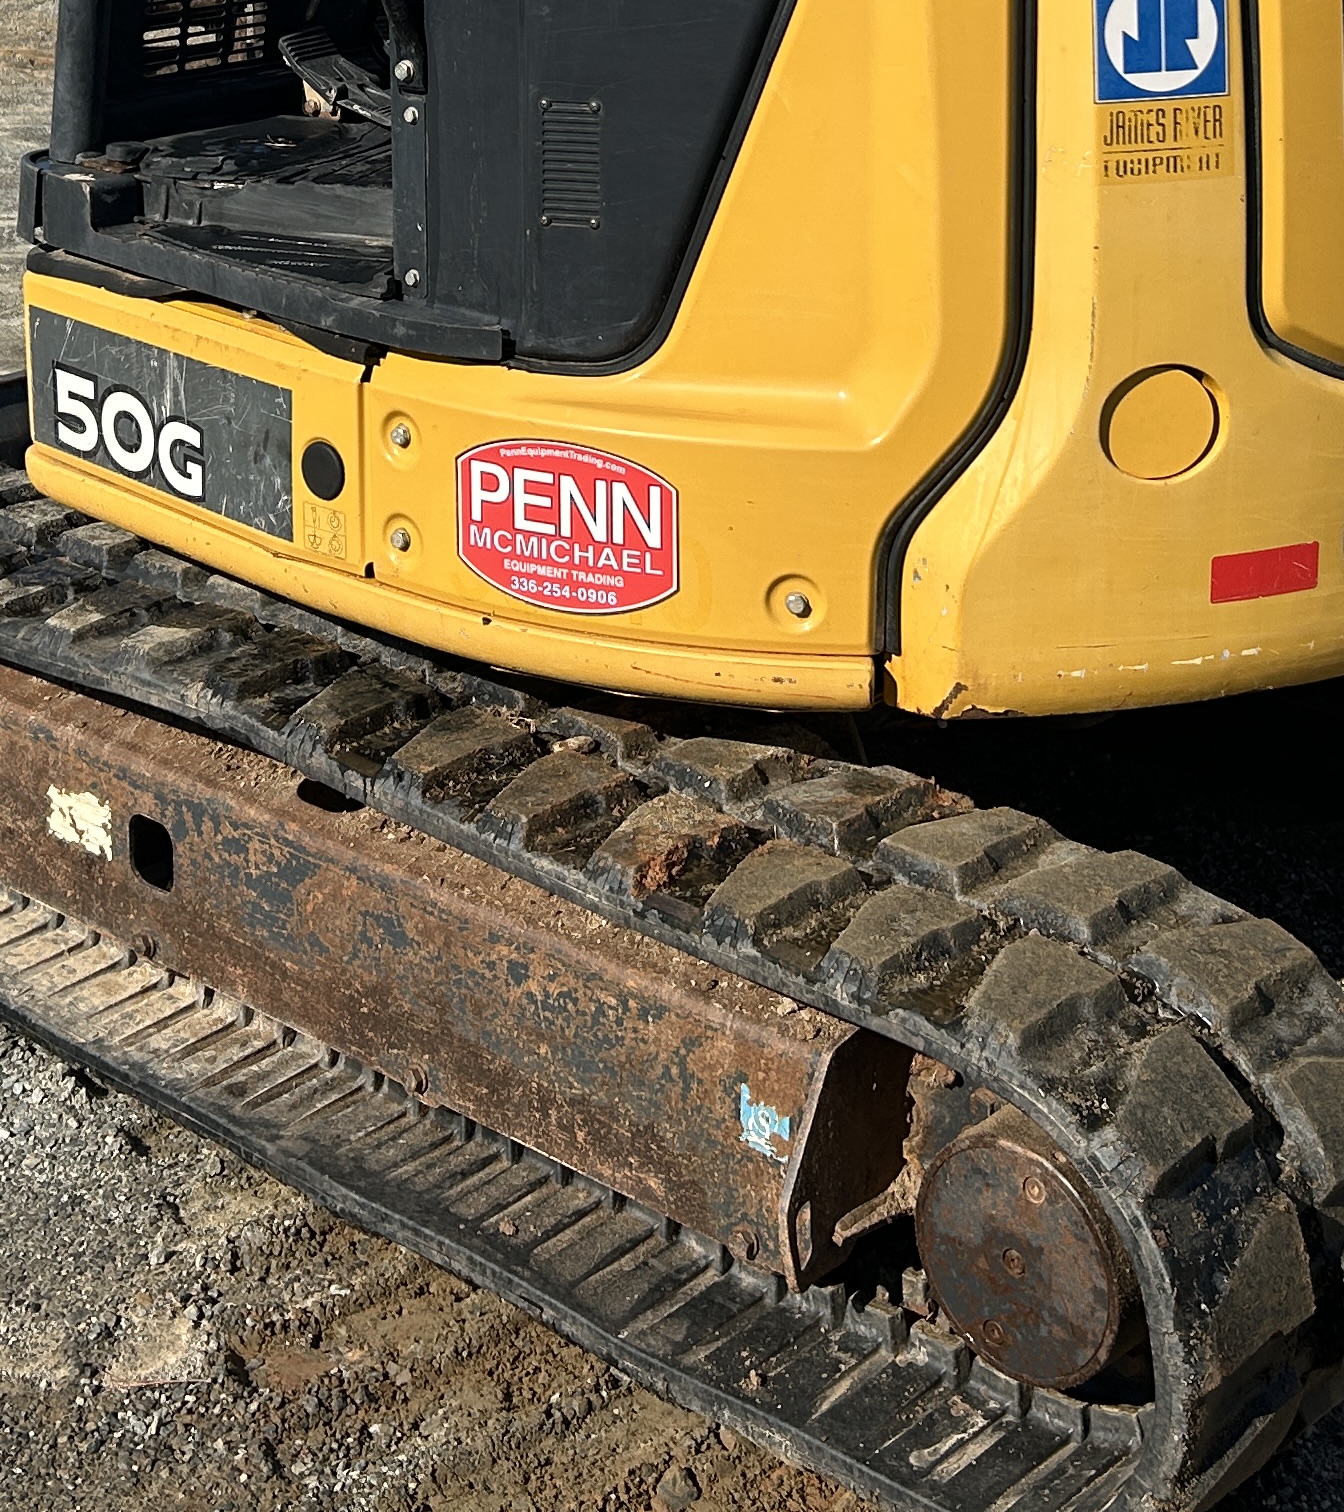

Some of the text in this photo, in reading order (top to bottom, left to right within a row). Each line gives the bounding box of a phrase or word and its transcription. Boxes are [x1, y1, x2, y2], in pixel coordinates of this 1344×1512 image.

[1103, 107, 1166, 147] JAMES
[54, 364, 205, 500] 50G
[499, 446, 626, 475] PennEquipmentTrading.com
[469, 459, 662, 550] PENN
[469, 524, 665, 575] MCMICHAEL
[503, 559, 624, 588] EQUIPMENT TRADING
[511, 576, 617, 606] 336-254-0906
